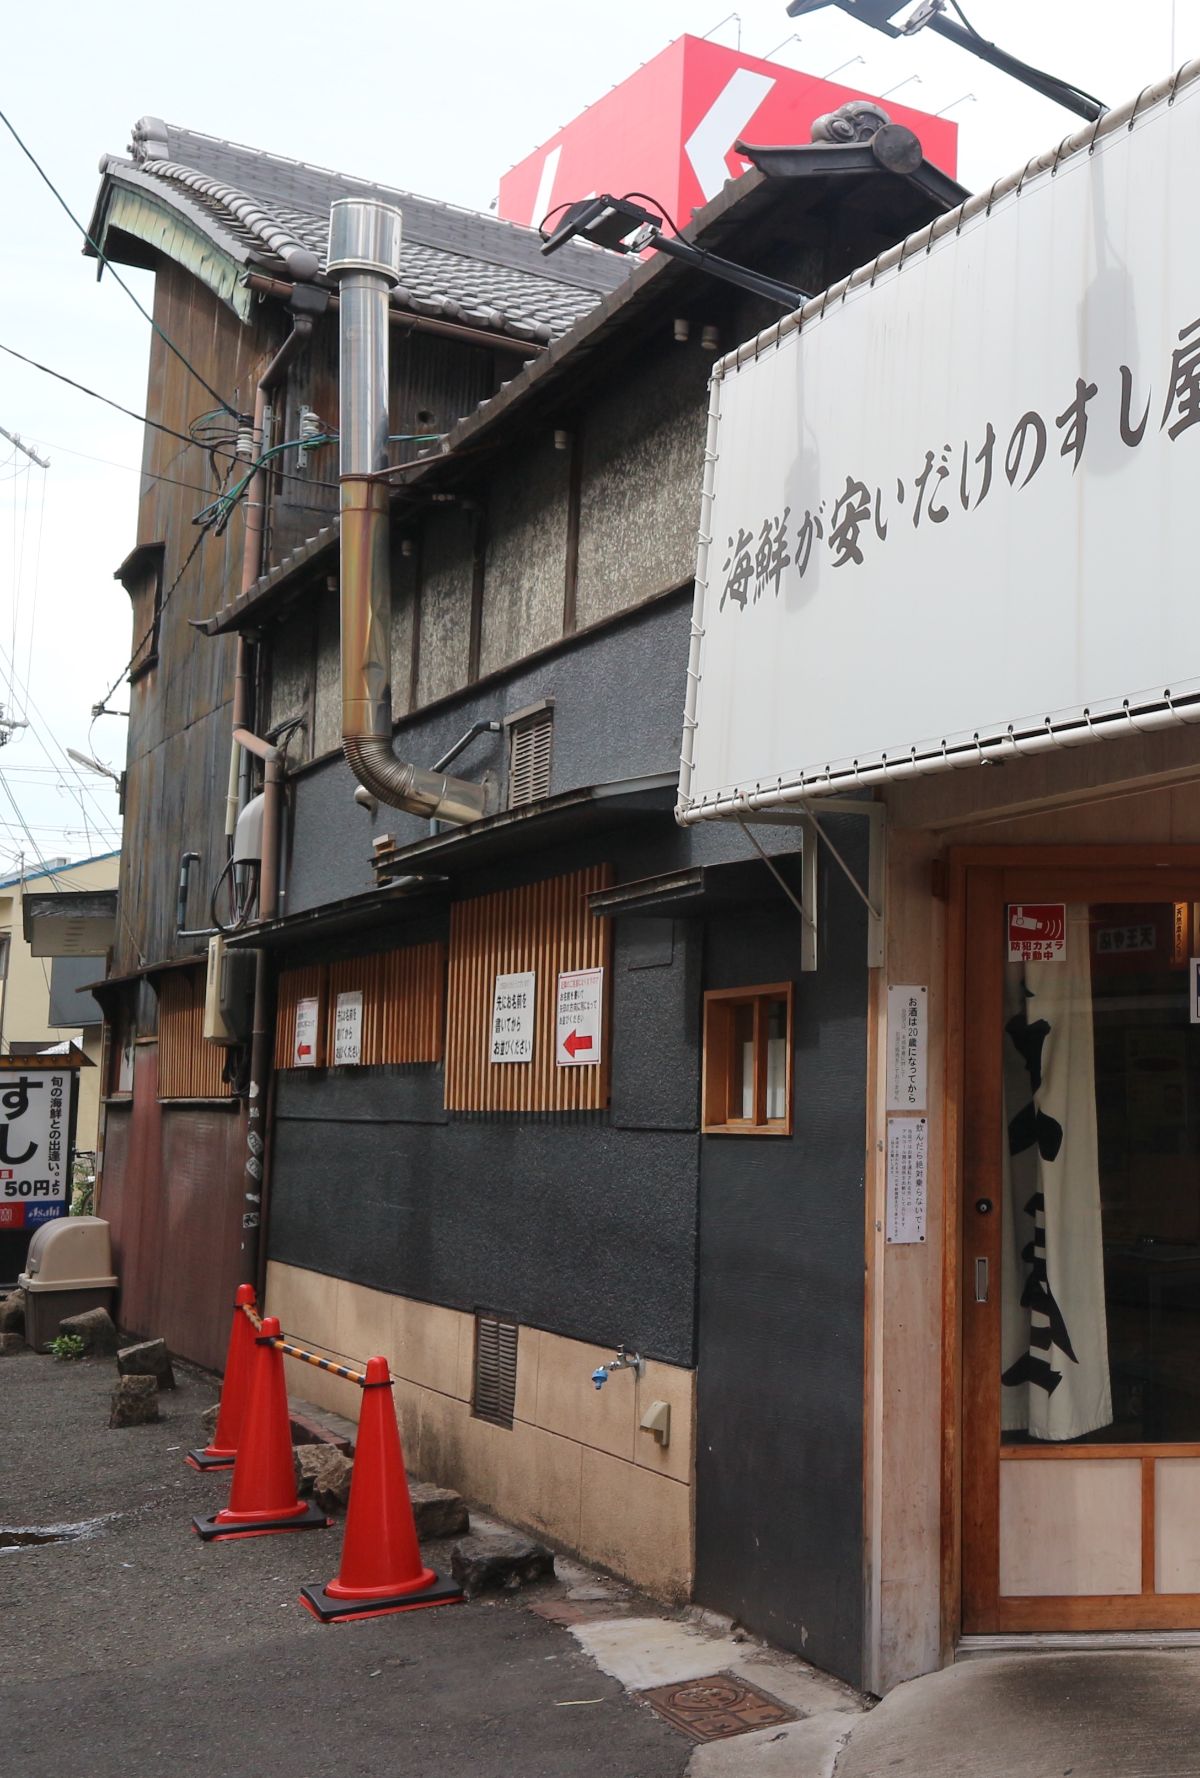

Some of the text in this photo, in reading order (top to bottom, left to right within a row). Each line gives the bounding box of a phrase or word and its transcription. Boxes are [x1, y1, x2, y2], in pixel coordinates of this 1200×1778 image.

[1011, 941, 1063, 951] 防犯カメラ
[1021, 951, 1054, 961] 作動中
[496, 993, 527, 1011] 先にお名前を
[495, 1016, 520, 1033] 書いてから
[907, 997, 918, 1104] お酒は20歳になってから
[0, 1076, 43, 1165] すし
[28, 1206, 60, 1219] Asahi
